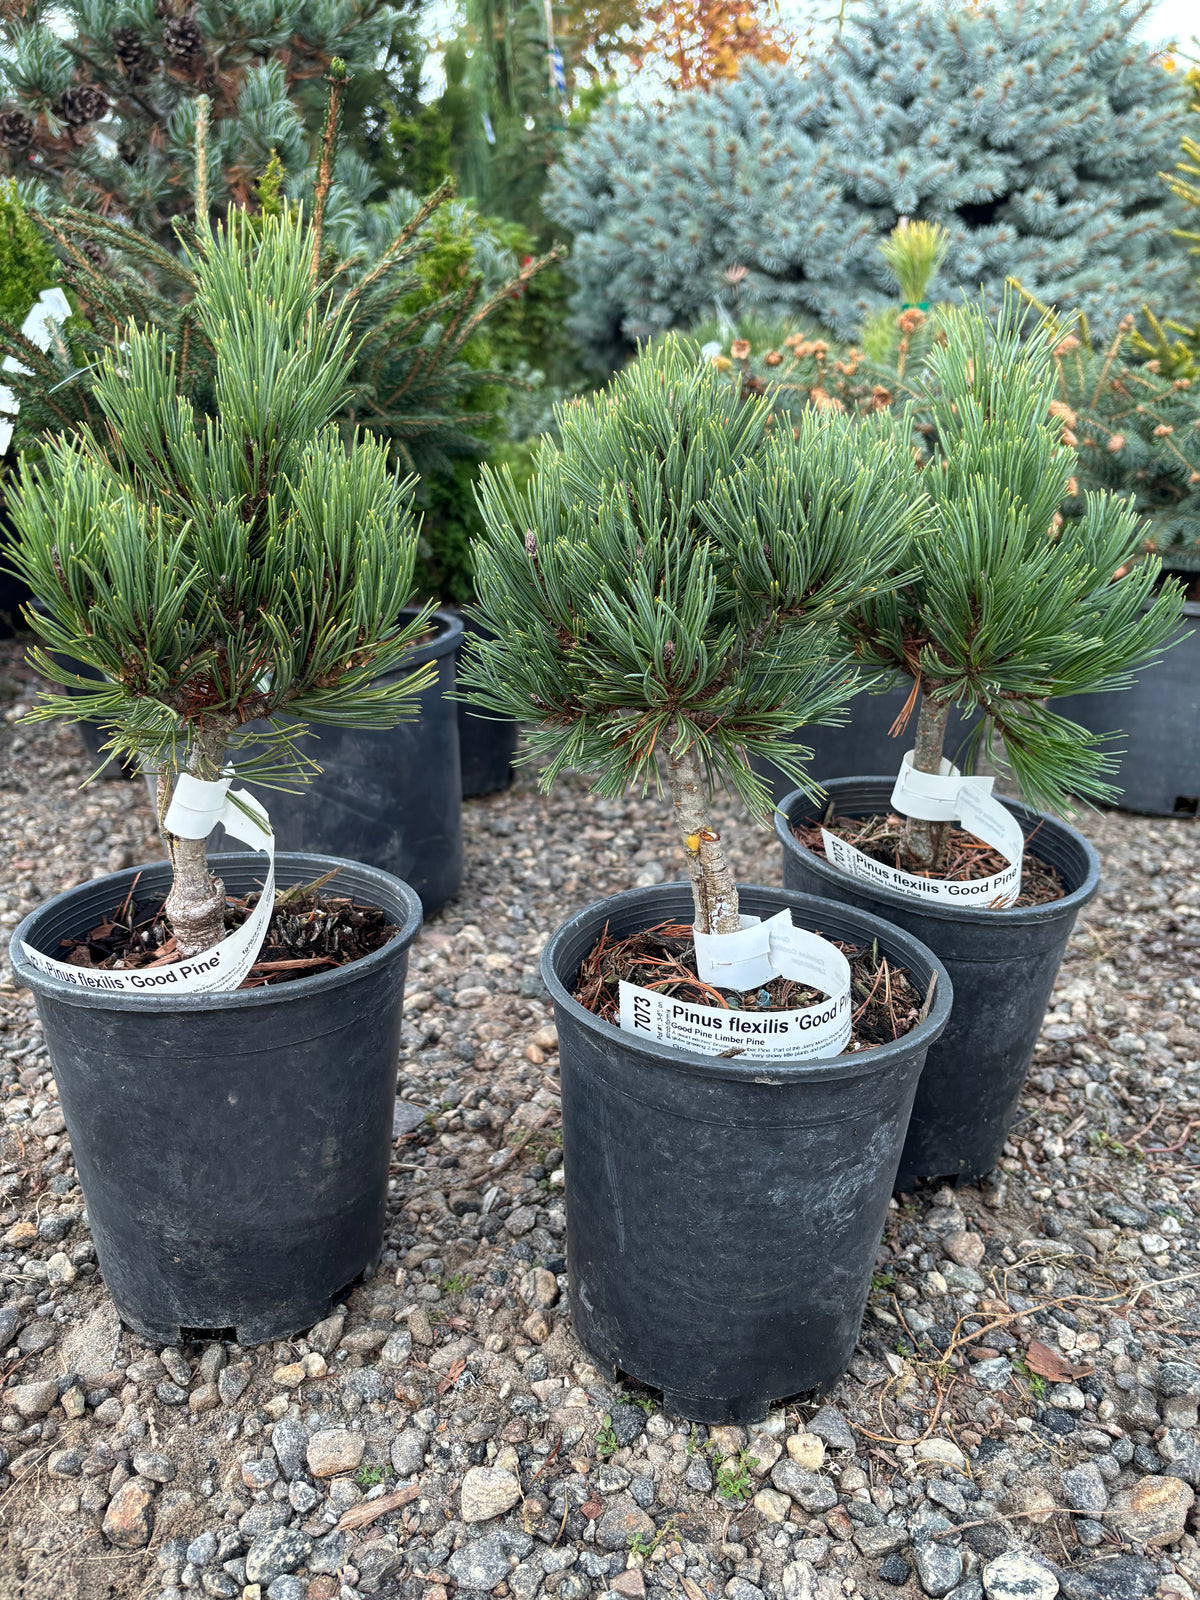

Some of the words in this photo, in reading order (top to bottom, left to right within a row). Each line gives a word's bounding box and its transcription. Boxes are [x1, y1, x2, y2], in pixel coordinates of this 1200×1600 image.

[856, 853, 890, 880] Pinus
[893, 873, 940, 895] flexilis
[943, 881, 989, 896] 'Good
[993, 862, 1019, 889] Pine'
[906, 889, 922, 898] Pine
[46, 961, 77, 984] Pinus
[78, 972, 125, 990] flexilis
[124, 970, 178, 989] 'Good
[179, 951, 221, 980] Pine'
[633, 995, 651, 1032] 7073
[673, 1005, 723, 1029] Pinus
[728, 1017, 789, 1033] flexilis
[795, 1002, 837, 1030] 'Good
[671, 1021, 693, 1034] Good
[694, 1028, 713, 1039] Pine
[714, 1033, 744, 1045] Limber
[746, 1037, 766, 1046] Pine
